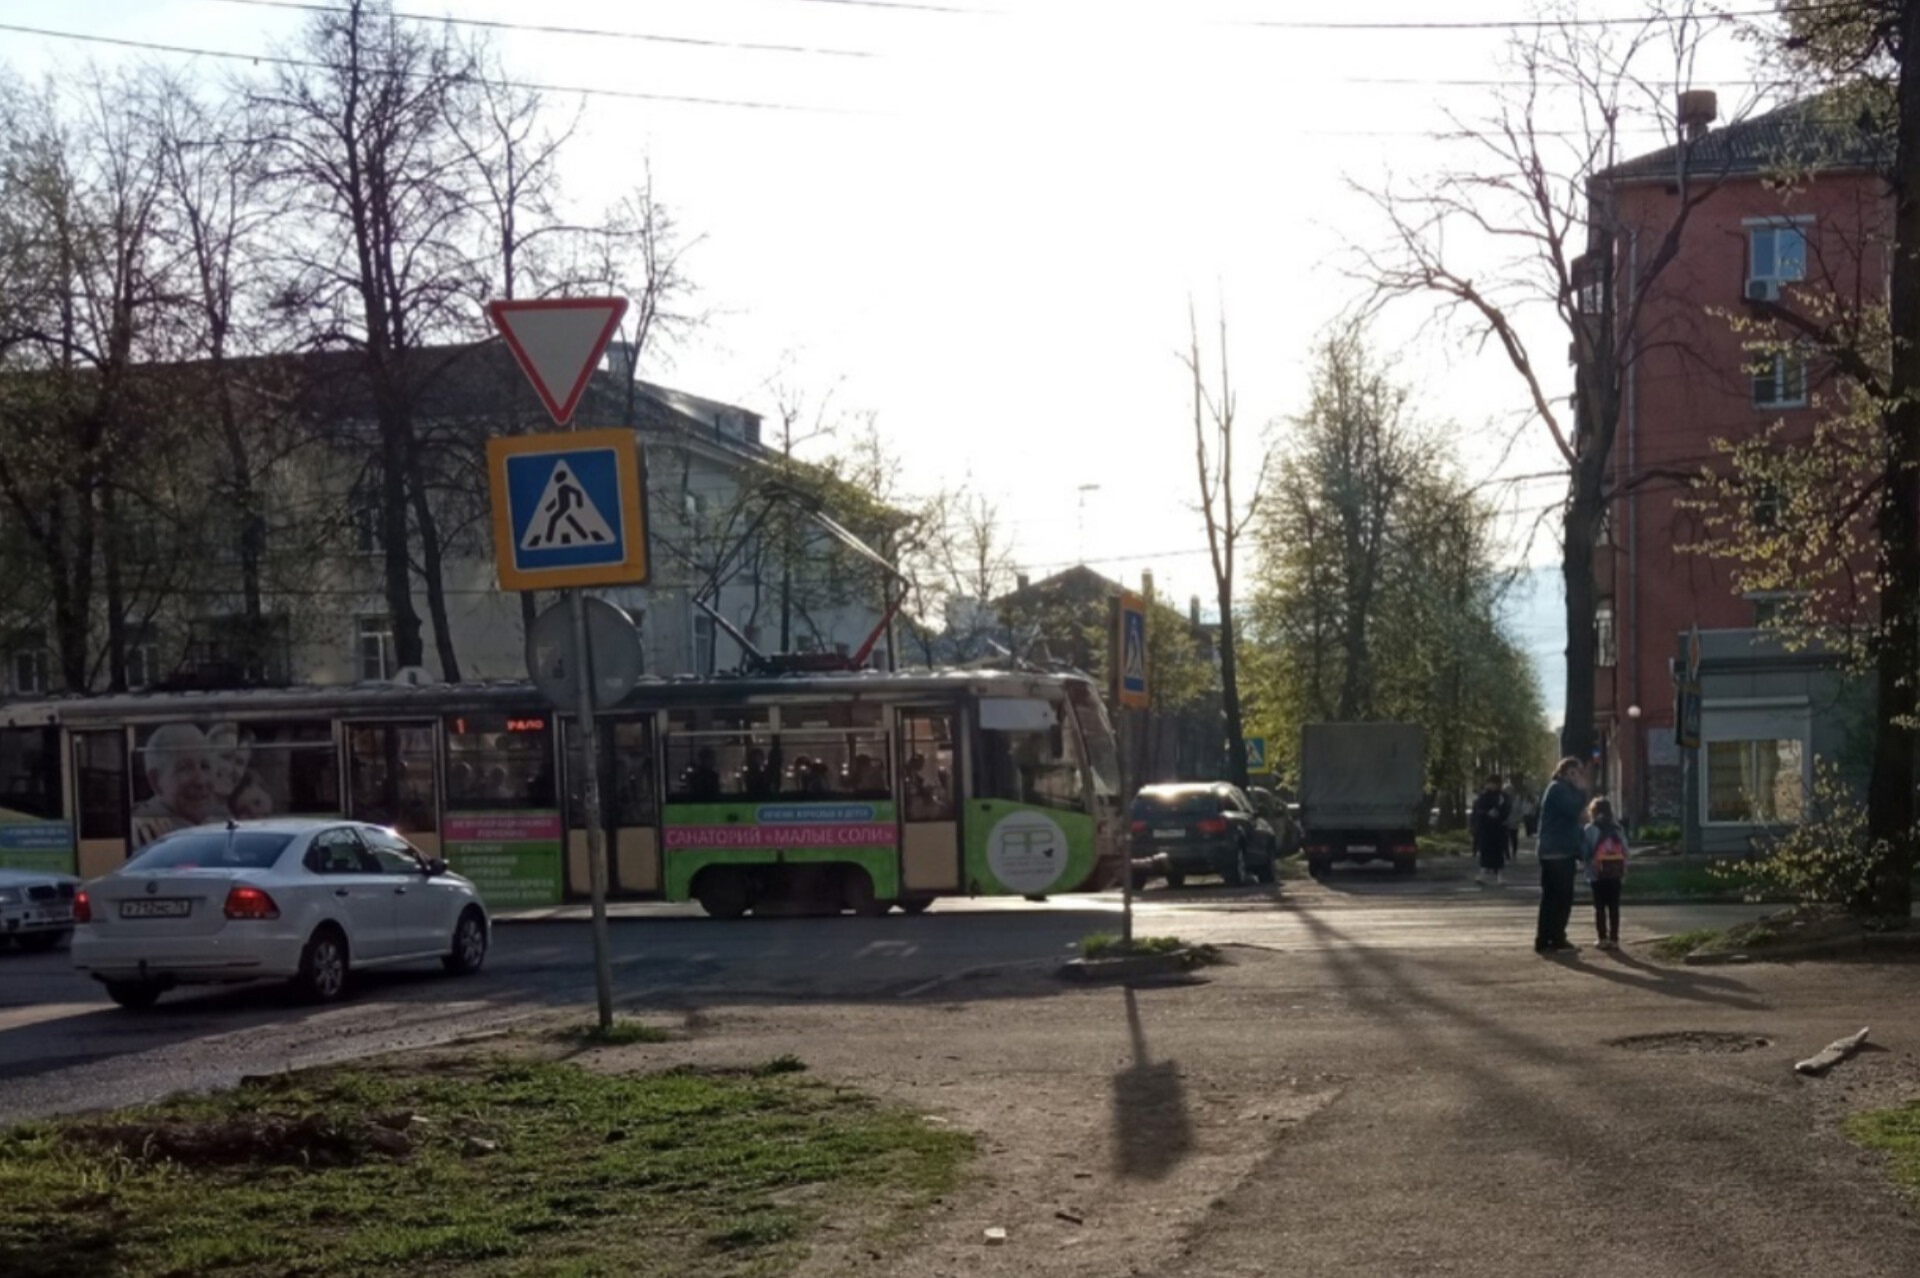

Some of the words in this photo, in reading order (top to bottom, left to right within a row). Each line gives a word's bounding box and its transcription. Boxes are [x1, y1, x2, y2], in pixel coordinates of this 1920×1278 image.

[666, 827, 761, 845] САНАТОРИЙ
[765, 828, 834, 844] «МАЛЫЕ
[838, 827, 893, 844] СОЛИ»
